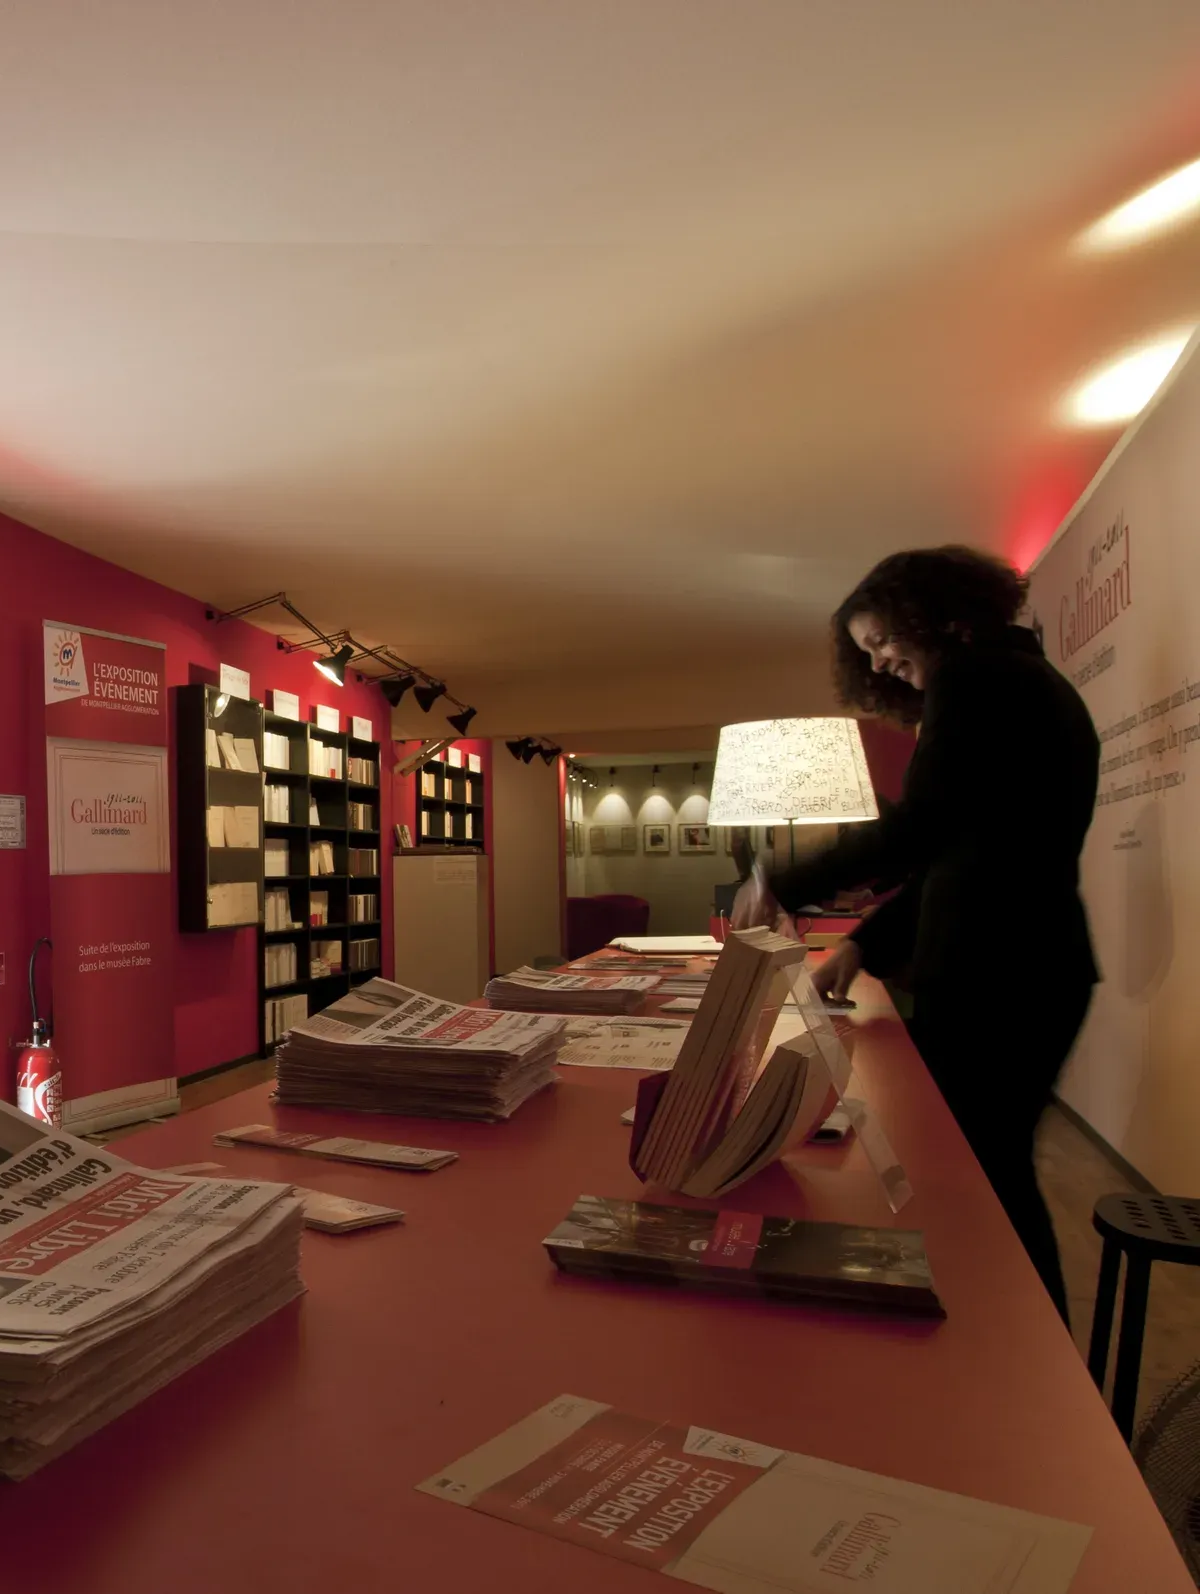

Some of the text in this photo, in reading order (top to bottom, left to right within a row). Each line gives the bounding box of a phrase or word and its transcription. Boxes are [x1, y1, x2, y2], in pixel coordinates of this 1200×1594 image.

[1060, 524, 1131, 662] Gallimard
[94, 662, 158, 686] L'EXPOSITION
[94, 678, 158, 704] ÉVÉNEMENT
[71, 798, 148, 824] Gallimard
[79, 940, 150, 956] Suite de l'exposition
[79, 956, 152, 972] dans le musée Fabre
[12, 1157, 112, 1210] Gallimard,
[87, 1178, 187, 1218] Midi
[213, 1185, 259, 1209] Exposition
[124, 1232, 161, 1250] musée
[151, 1241, 176, 1249] du
[92, 1251, 135, 1270] Fabre
[105, 1256, 151, 1283] octobre
[7, 1281, 56, 1304] ouverts
[34, 1289, 76, 1307] livres
[48, 1287, 112, 1314] Parcours
[578, 1457, 695, 1538] ÉVÉNEMENT
[623, 1470, 735, 1553] L'EXPOSITION
[819, 1512, 901, 1582] Gallimard
